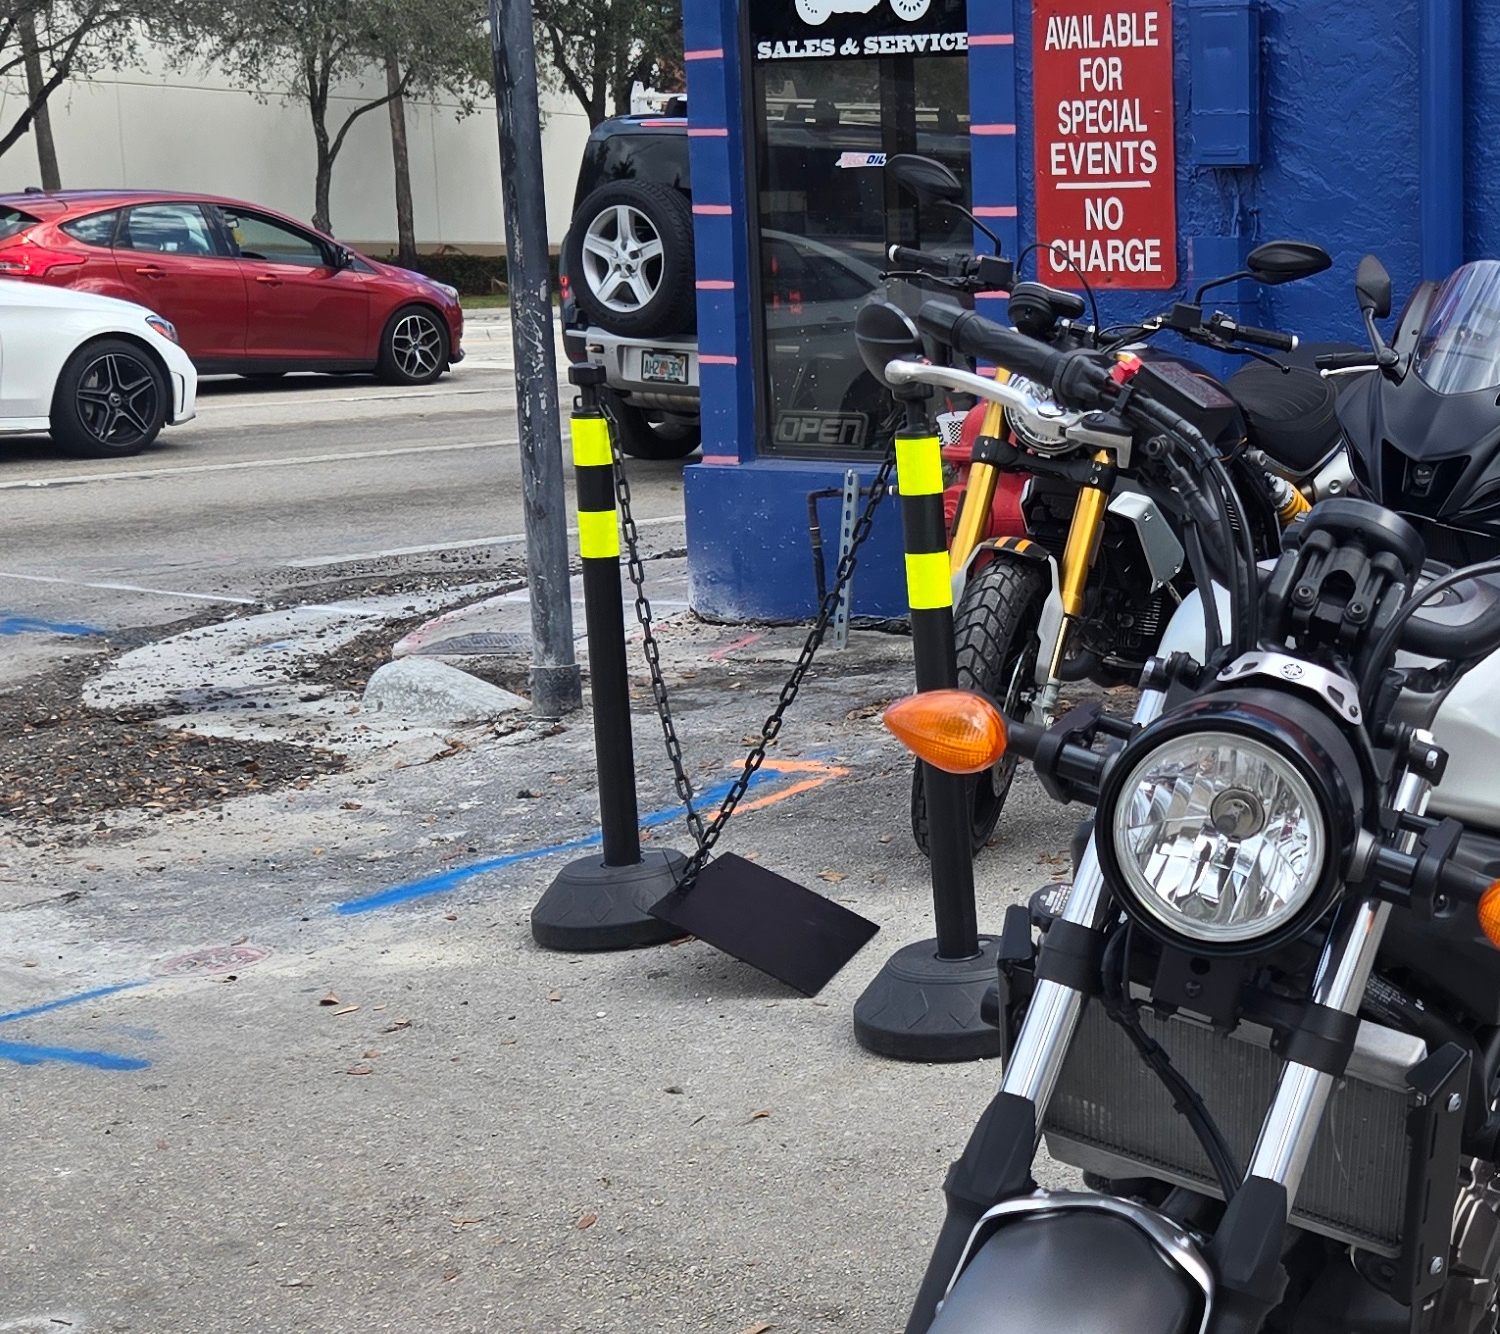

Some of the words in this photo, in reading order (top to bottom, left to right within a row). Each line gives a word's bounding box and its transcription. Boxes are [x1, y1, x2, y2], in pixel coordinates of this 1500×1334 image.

[757, 38, 836, 60] SALES
[840, 38, 860, 55] &
[863, 32, 968, 55] SERVICE
[1045, 12, 1158, 51] AVAILABLE
[1079, 56, 1123, 92] FOR
[1058, 98, 1148, 136] SPECIAL
[1051, 140, 1157, 176] EVENTS
[1085, 197, 1124, 231] NO
[1050, 239, 1162, 272] CHARGE
[778, 417, 862, 444] OPEN
